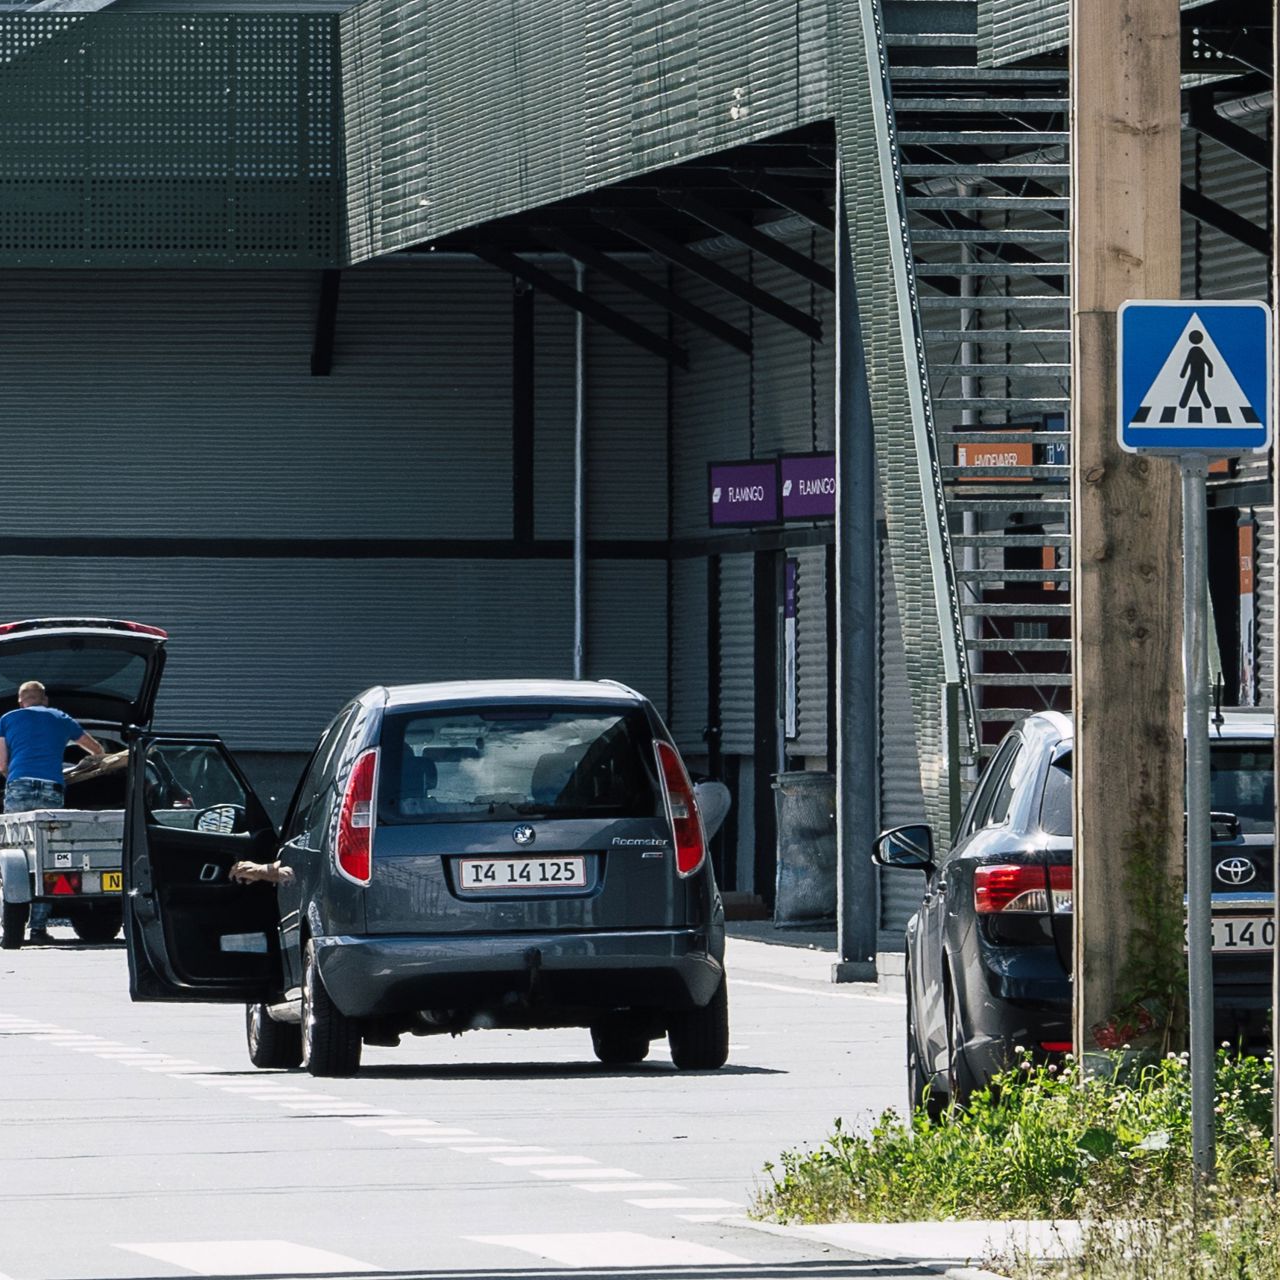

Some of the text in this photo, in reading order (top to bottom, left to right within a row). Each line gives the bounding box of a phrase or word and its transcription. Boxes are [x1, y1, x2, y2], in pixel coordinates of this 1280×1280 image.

[728, 486, 764, 502] FLAMINGO
[799, 478, 836, 495] FLAMINGO
[611, 836, 669, 847] Roomster
[507, 863, 531, 882] 14
[539, 862, 576, 882] 125
